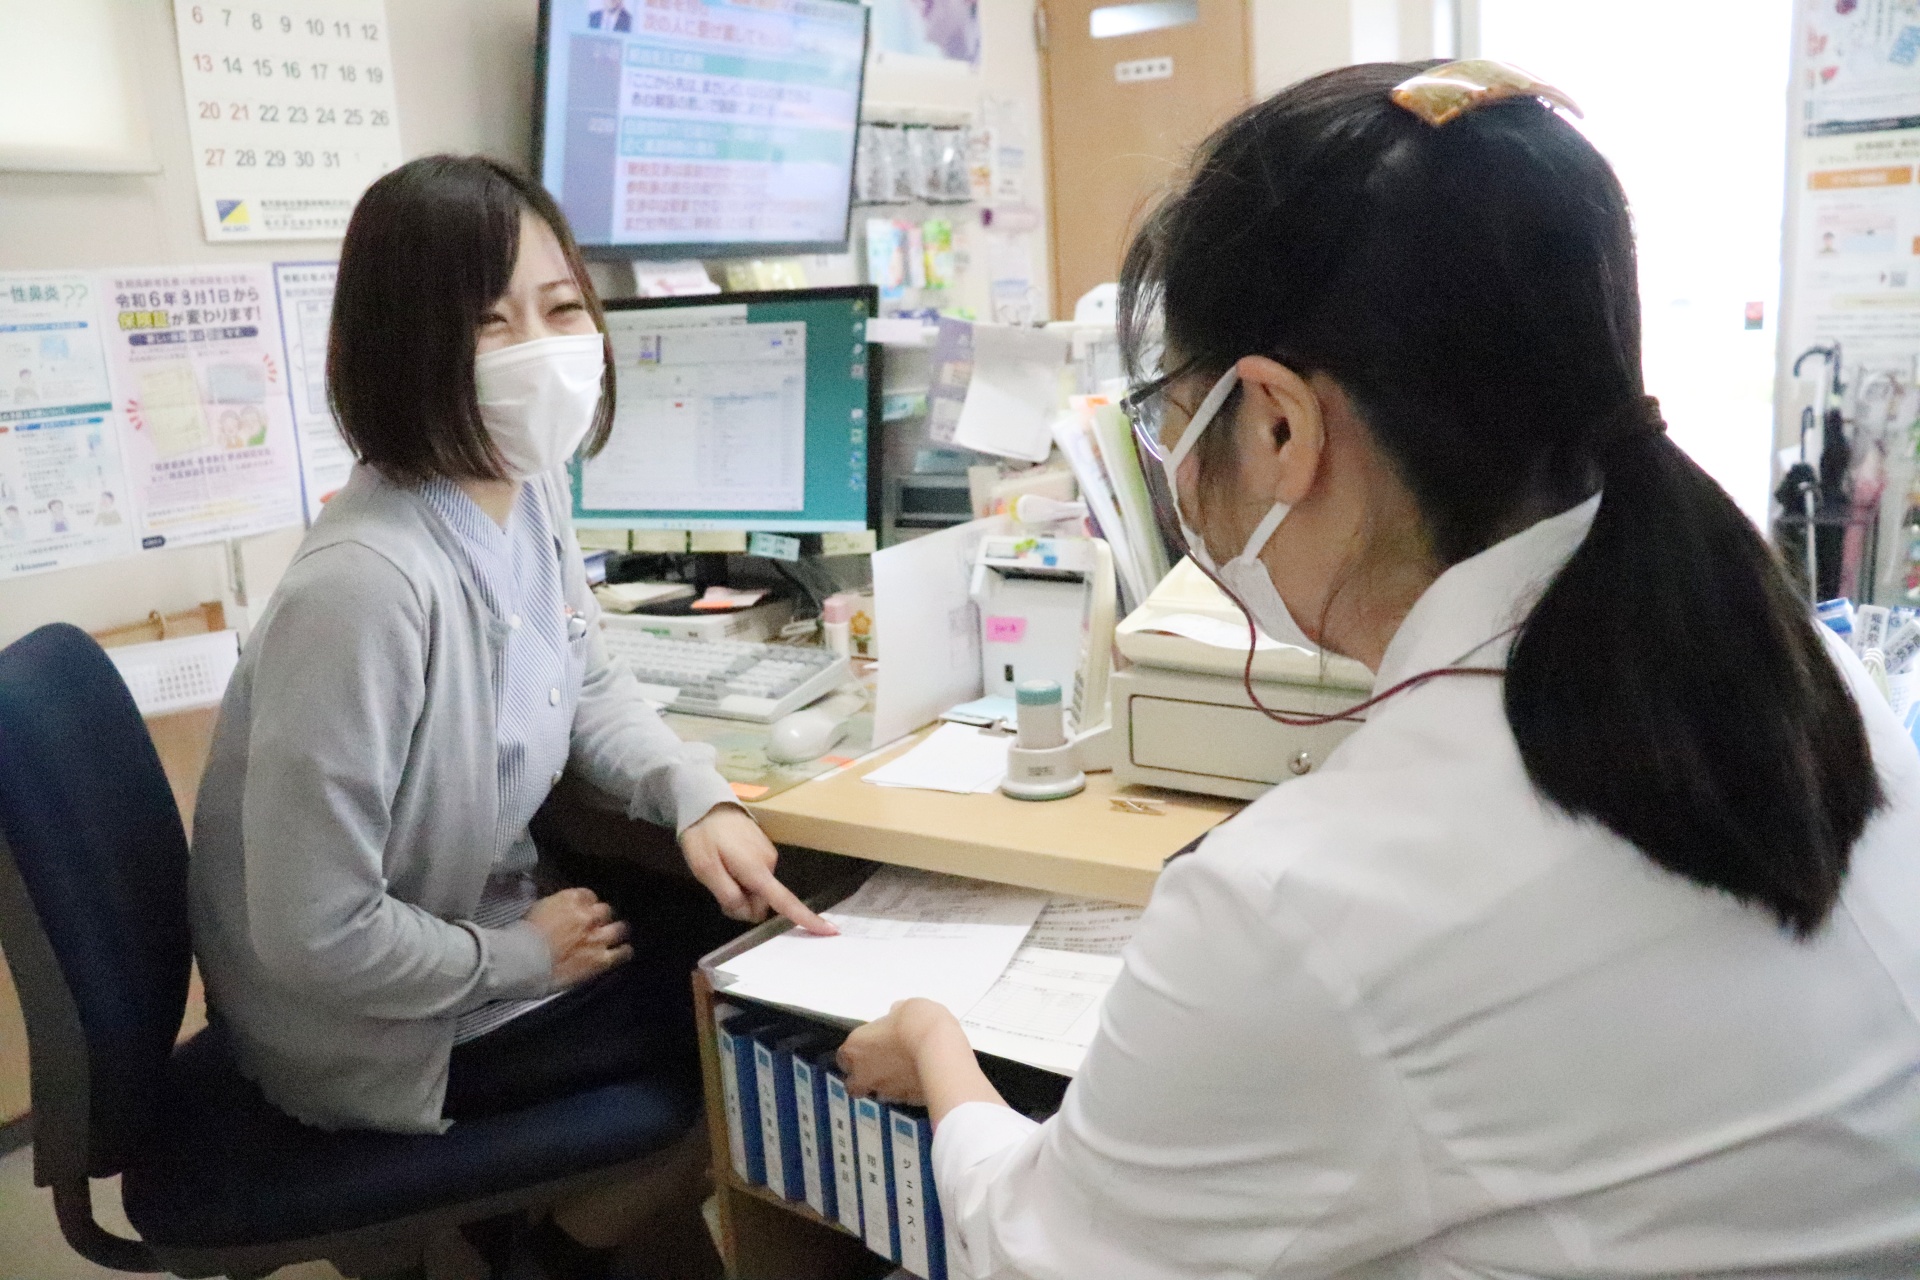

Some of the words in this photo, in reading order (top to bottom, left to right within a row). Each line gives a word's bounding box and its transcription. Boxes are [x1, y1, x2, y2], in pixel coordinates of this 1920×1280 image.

[192, 6, 203, 24] 6
[221, 8, 232, 26] 7
[251, 12, 263, 31] 8
[280, 16, 291, 33] 9
[306, 18, 324, 36] 10
[334, 21, 350, 38] 11
[361, 24, 378, 41] 12
[193, 54, 213, 72] 13
[223, 56, 242, 74] 14
[253, 59, 273, 77] 15
[282, 62, 301, 79] 16
[311, 63, 328, 79] 17
[338, 65, 356, 82] 18
[366, 67, 383, 84] 19
[199, 101, 220, 120] 20
[230, 103, 249, 121] 21
[259, 105, 279, 122] 22
[287, 106, 308, 124] 23
[316, 107, 336, 124] 24
[344, 108, 363, 125] 25
[371, 110, 389, 126] 26
[205, 148, 225, 167] 27
[235, 149, 256, 167] 28
[265, 150, 286, 167] 29
[294, 150, 314, 168] 30
[323, 151, 340, 168] 31
